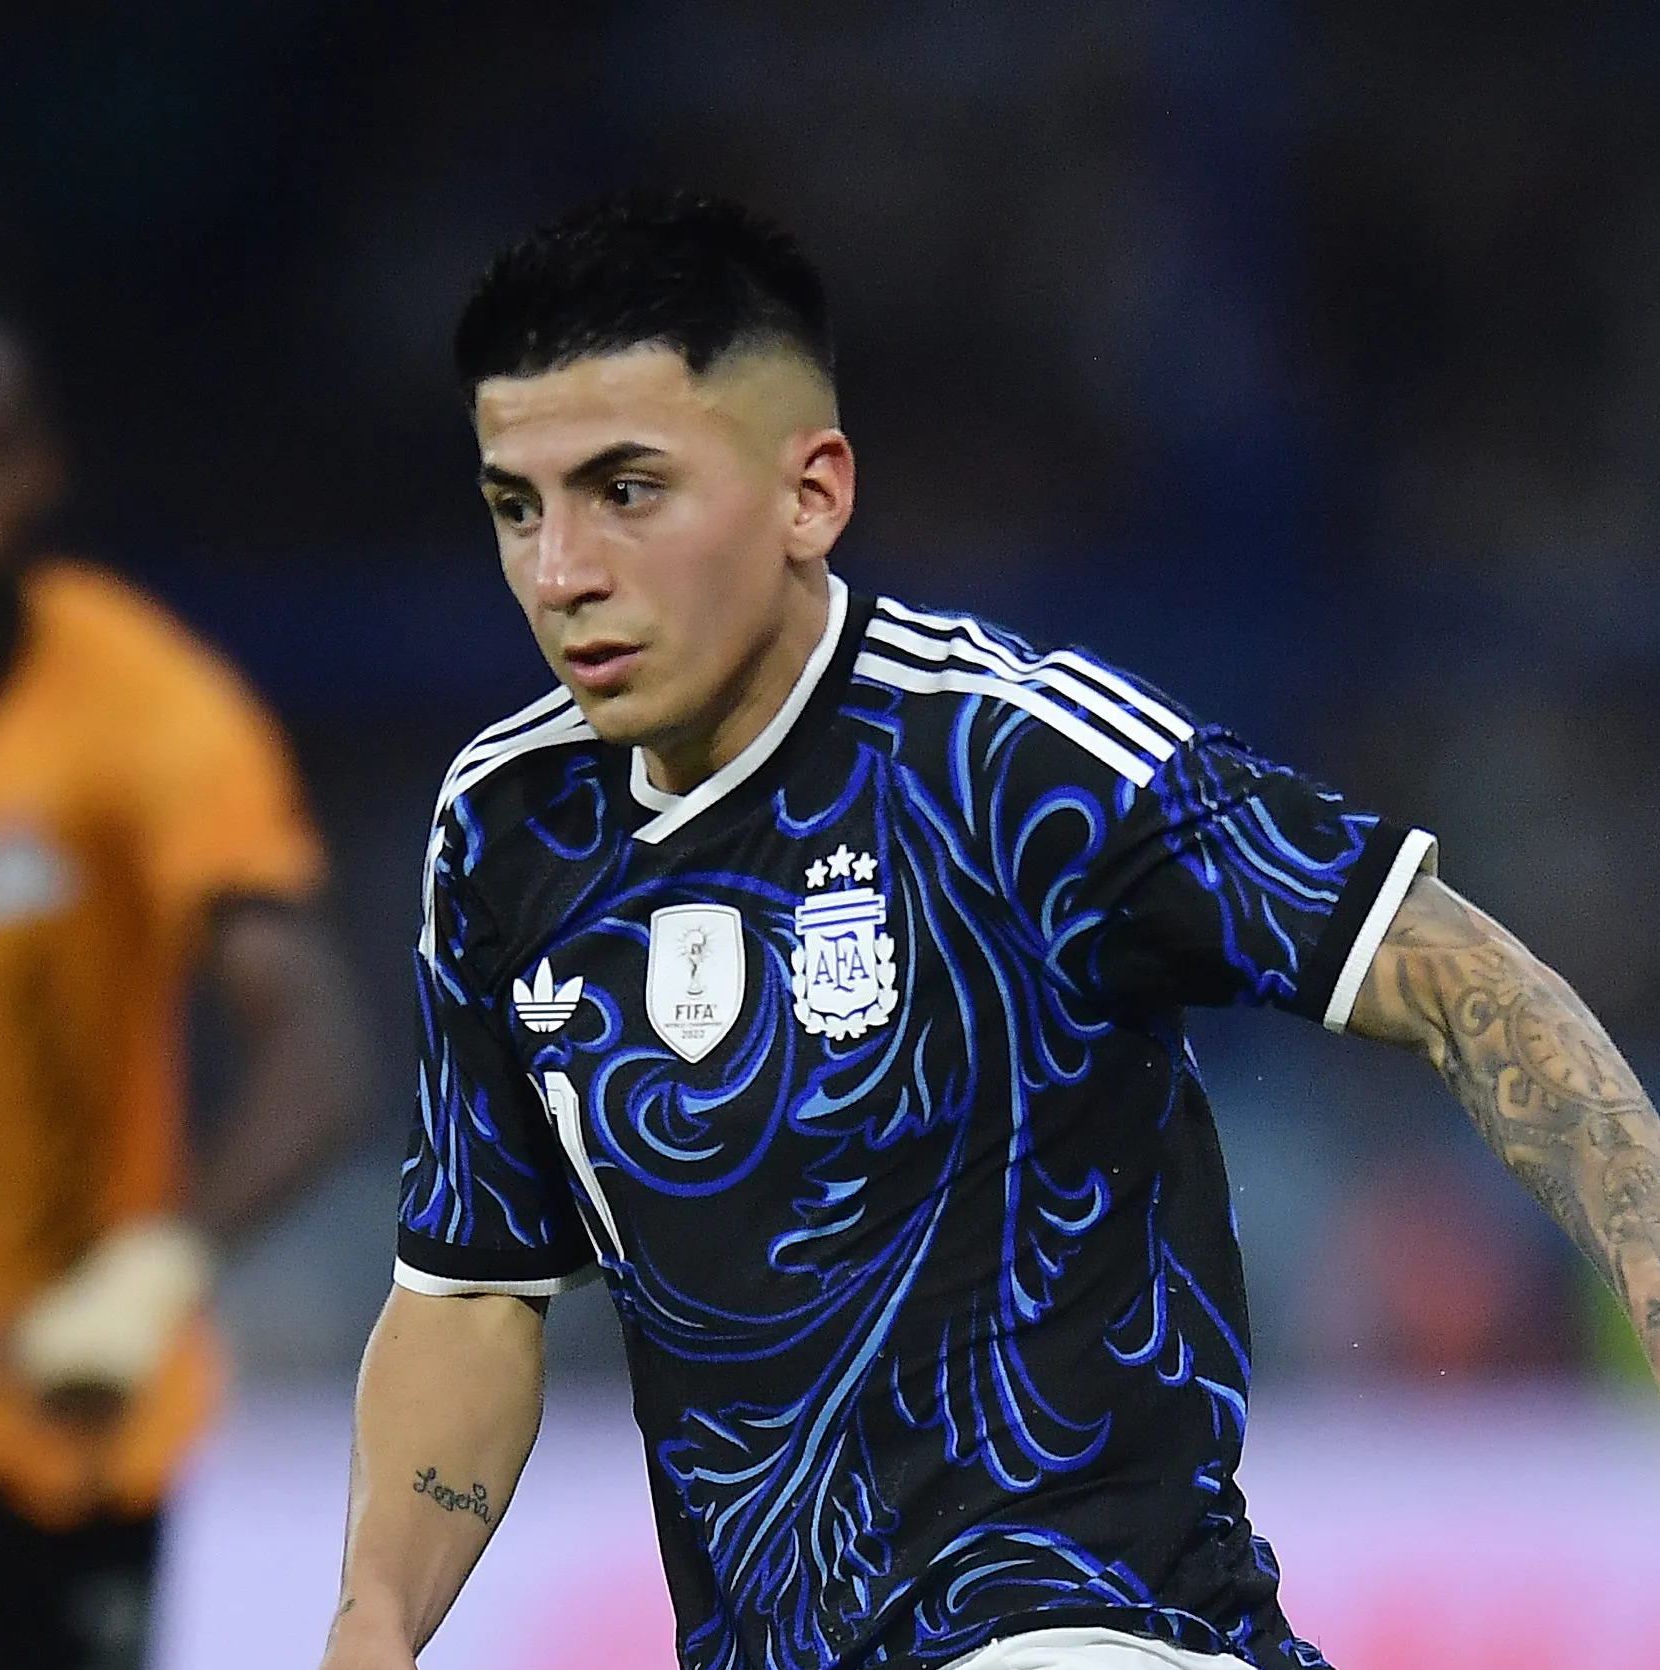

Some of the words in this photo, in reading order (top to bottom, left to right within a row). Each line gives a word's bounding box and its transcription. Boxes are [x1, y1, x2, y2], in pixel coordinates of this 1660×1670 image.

[813, 930, 870, 993] AFA
[675, 1003, 715, 1021] FIFA
[527, 1070, 626, 1266] 1
